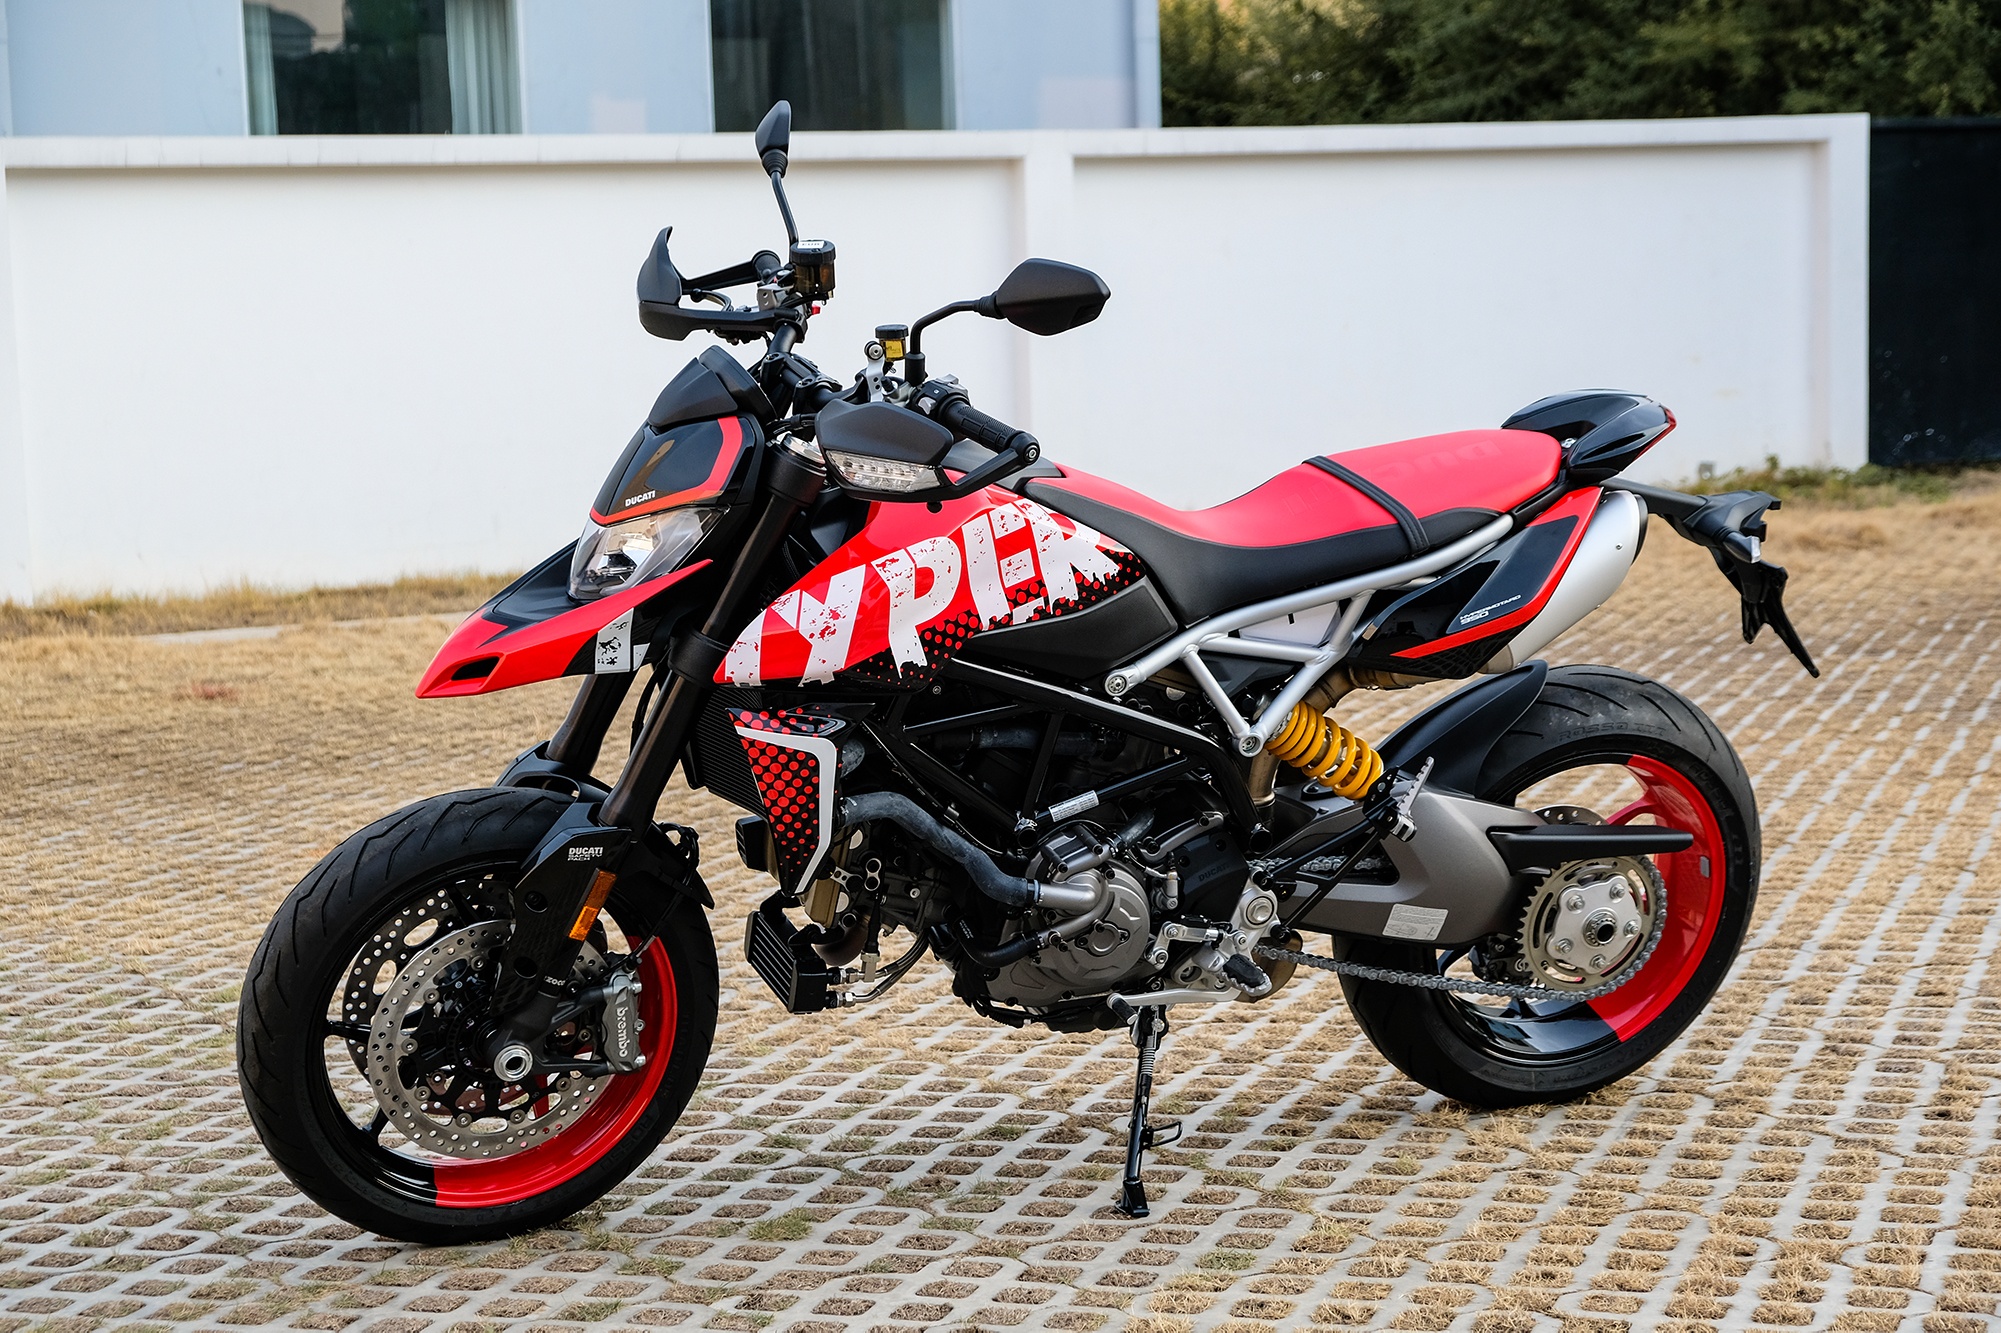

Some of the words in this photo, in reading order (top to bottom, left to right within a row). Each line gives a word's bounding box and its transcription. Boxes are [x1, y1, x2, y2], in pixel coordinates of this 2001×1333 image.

[625, 490, 656, 507] DUCATI
[568, 846, 604, 855] DUCATI
[616, 1006, 631, 1058] brembo
